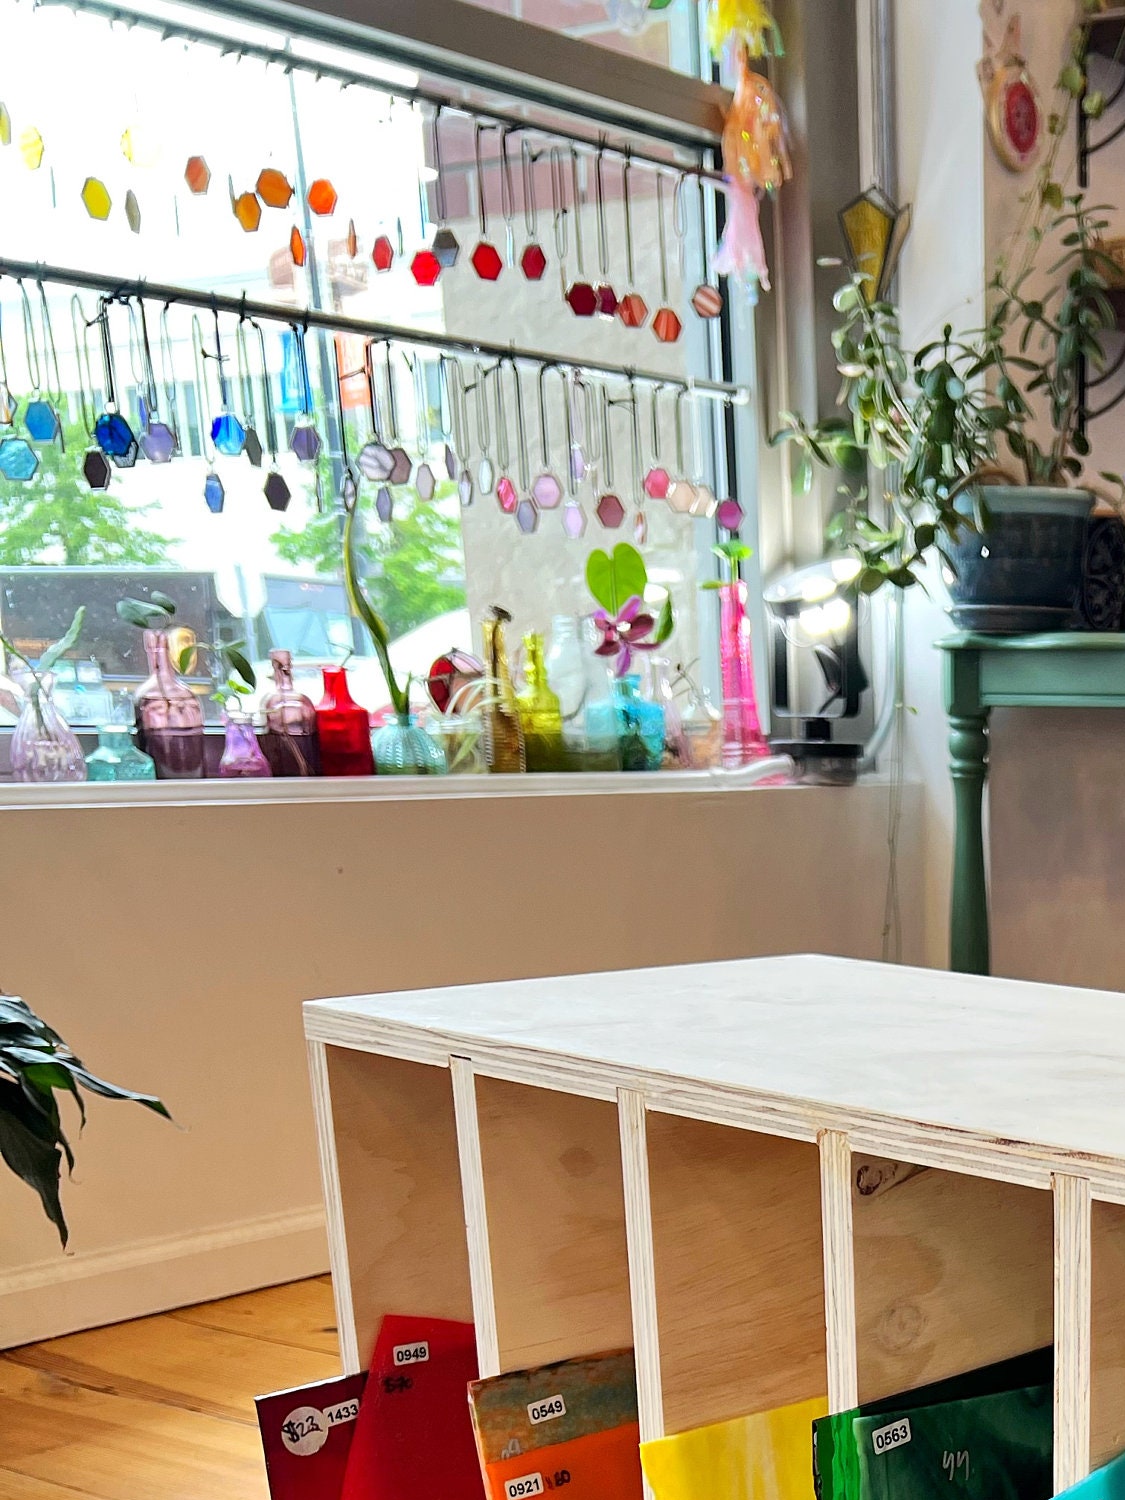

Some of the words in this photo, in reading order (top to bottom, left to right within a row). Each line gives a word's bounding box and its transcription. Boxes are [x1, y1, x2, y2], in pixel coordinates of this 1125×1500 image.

[396, 1346, 427, 1362] 0949
[327, 1404, 359, 1423] 1433
[532, 1400, 563, 1420] 0549
[282, 1415, 324, 1443] $23
[876, 1425, 908, 1449] 0563
[509, 1478, 540, 1498] 0921
